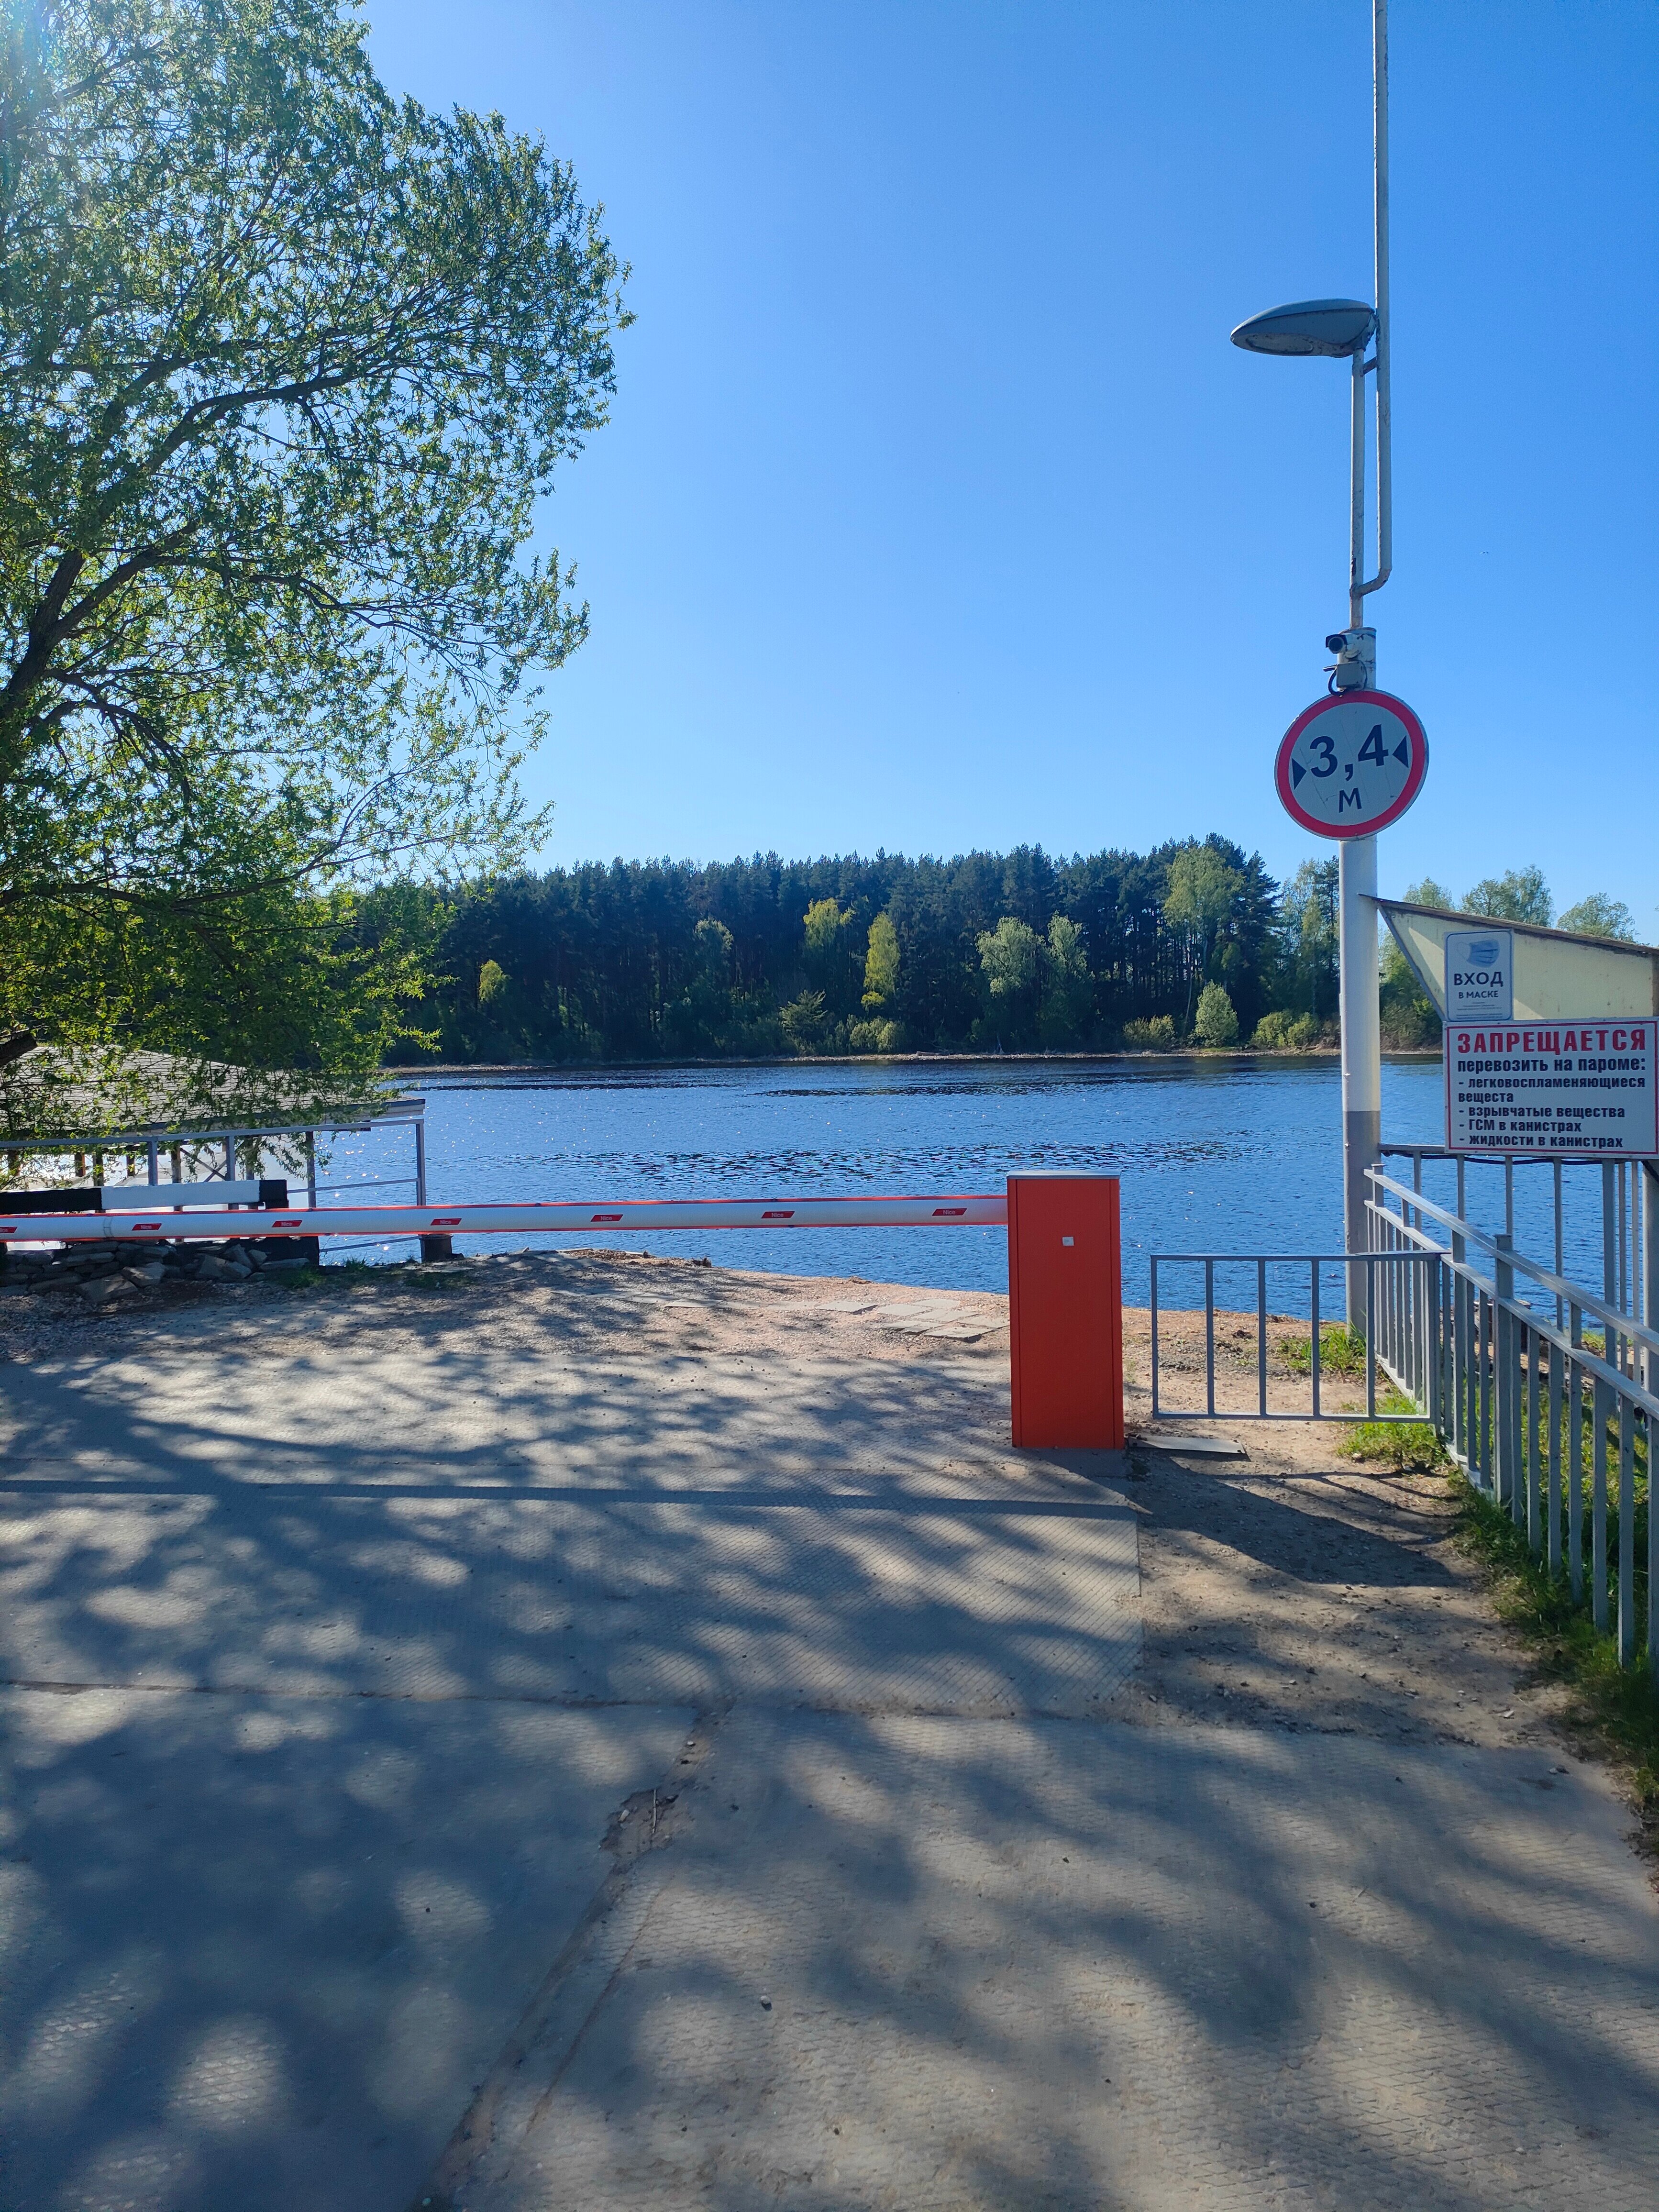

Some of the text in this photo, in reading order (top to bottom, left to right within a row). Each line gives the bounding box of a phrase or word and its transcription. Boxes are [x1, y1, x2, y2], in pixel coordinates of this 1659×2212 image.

[1309, 724, 1389, 782] 3,4
[1454, 971, 1504, 988] ВХОД
[1466, 990, 1499, 998] МАСКЕ
[1457, 1029, 1646, 1055] ЗАПРЕЩАЕТСЯ
[1458, 1058, 1646, 1074] перевозить на пароме:
[1468, 1077, 1645, 1090] легковоспламеняющиеся
[1458, 1093, 1514, 1104] вещеста
[1469, 1107, 1552, 1118] взрывчатые
[1556, 1107, 1625, 1119] вещества
[1469, 1119, 1495, 1131] ГСМ
[1499, 1121, 1506, 1131] в
[1510, 1122, 1582, 1134] канистрах
[1469, 1135, 1534, 1147] жидкости
[1538, 1136, 1546, 1146] в
[1550, 1137, 1623, 1149] канистрах
